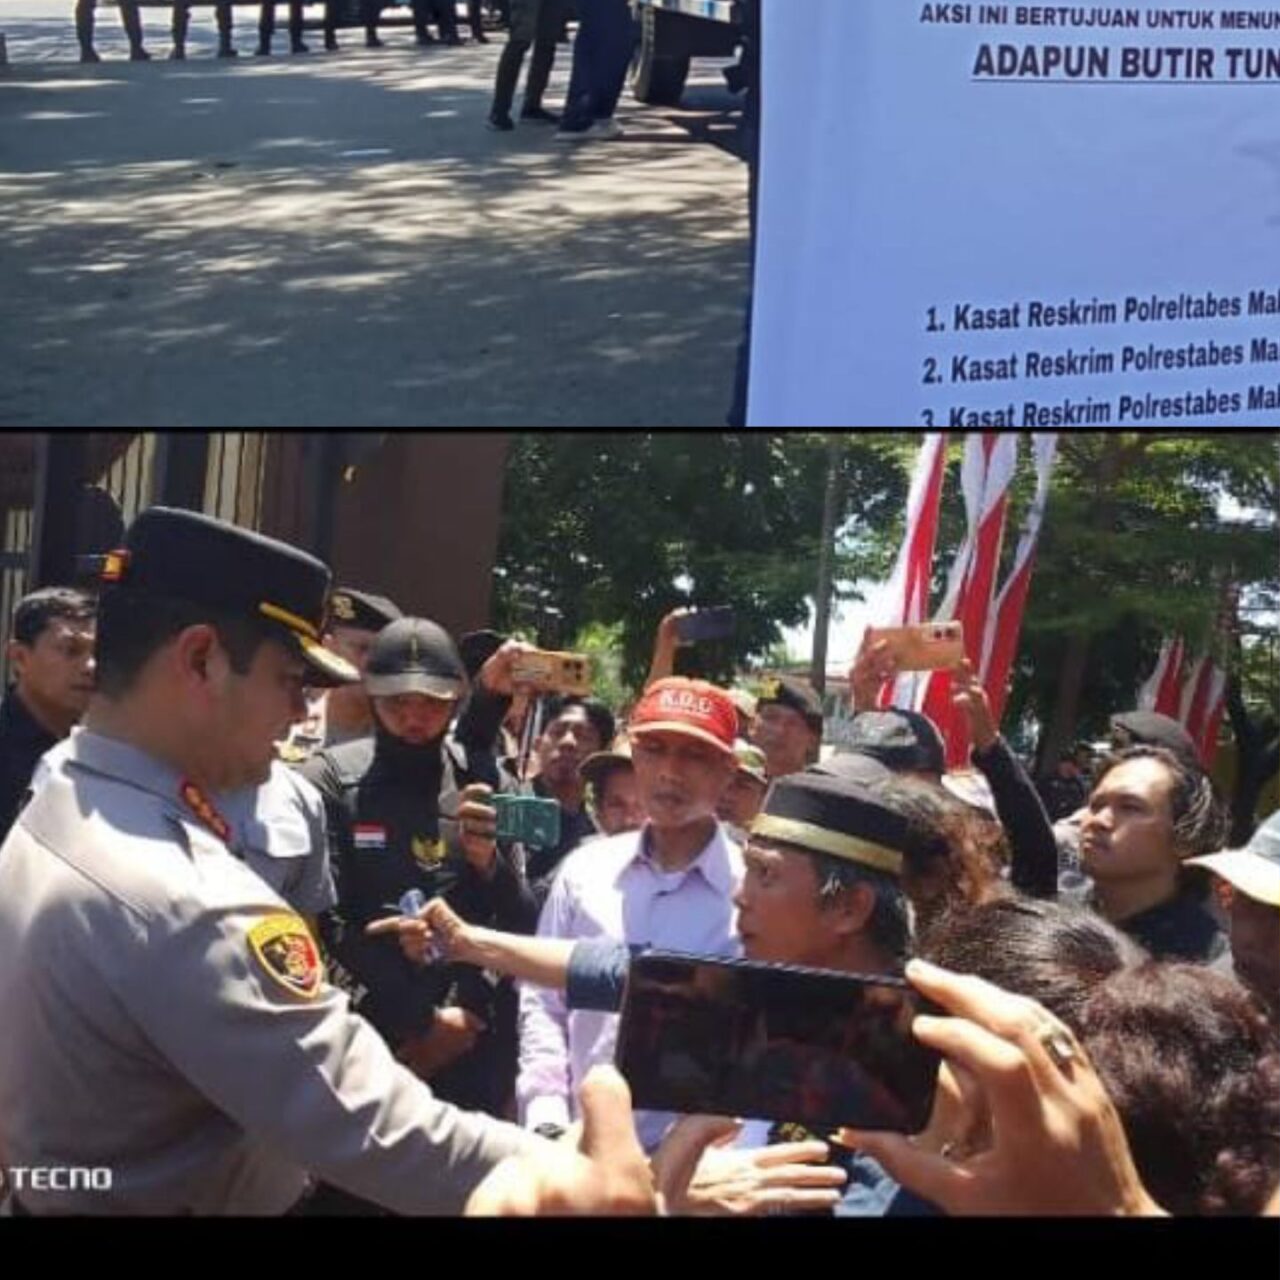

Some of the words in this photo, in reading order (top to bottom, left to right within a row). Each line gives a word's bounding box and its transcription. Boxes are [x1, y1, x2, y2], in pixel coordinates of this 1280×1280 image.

[919, 3, 971, 24] AKSI
[979, 5, 1008, 25] INI
[1015, 6, 1139, 28] BERTUJUAN
[1146, 9, 1215, 29] UNTUK
[972, 43, 1109, 78] ADAPUN
[1120, 46, 1215, 78] BUTIR
[926, 306, 945, 333] 1.
[954, 302, 1020, 330] Kasat
[1027, 297, 1116, 328] Reskrim
[1124, 290, 1241, 323] Polreltabes
[922, 357, 943, 384] 2.
[952, 352, 1018, 383] Kasat
[1025, 347, 1114, 377] Reskrim
[1122, 340, 1244, 371] Polrestabes
[951, 404, 1015, 426] Kasat
[1023, 398, 1111, 426] Reskrim
[1119, 389, 1241, 421] Polrestabes
